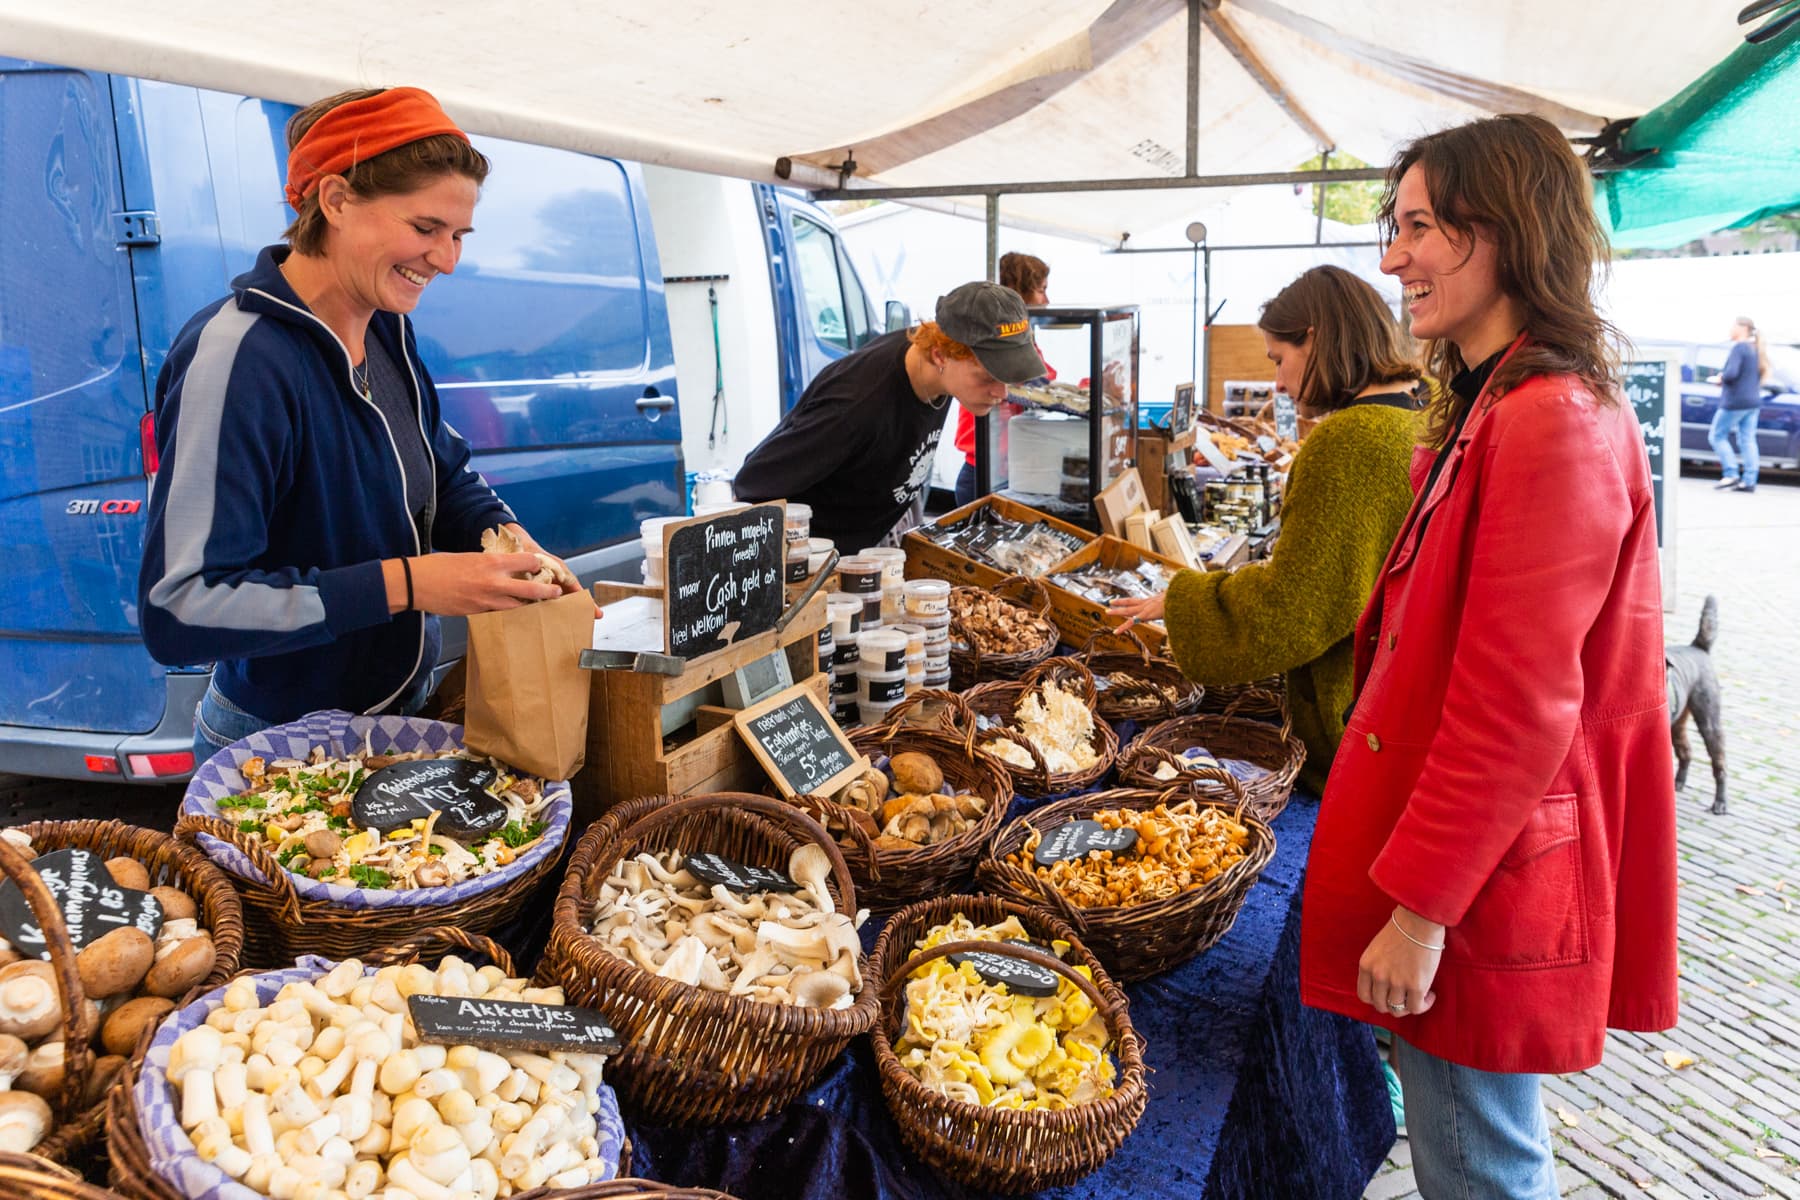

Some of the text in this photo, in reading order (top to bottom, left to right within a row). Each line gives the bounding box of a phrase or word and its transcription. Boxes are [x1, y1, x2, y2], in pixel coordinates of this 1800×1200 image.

[66, 499, 142, 515] 311 CDI
[705, 524, 737, 554] Pinnen
[679, 579, 701, 600] maar
[706, 572, 738, 613] Cash
[741, 568, 760, 606] geld
[672, 624, 688, 646] heel
[458, 999, 576, 1024] Akkertjes
